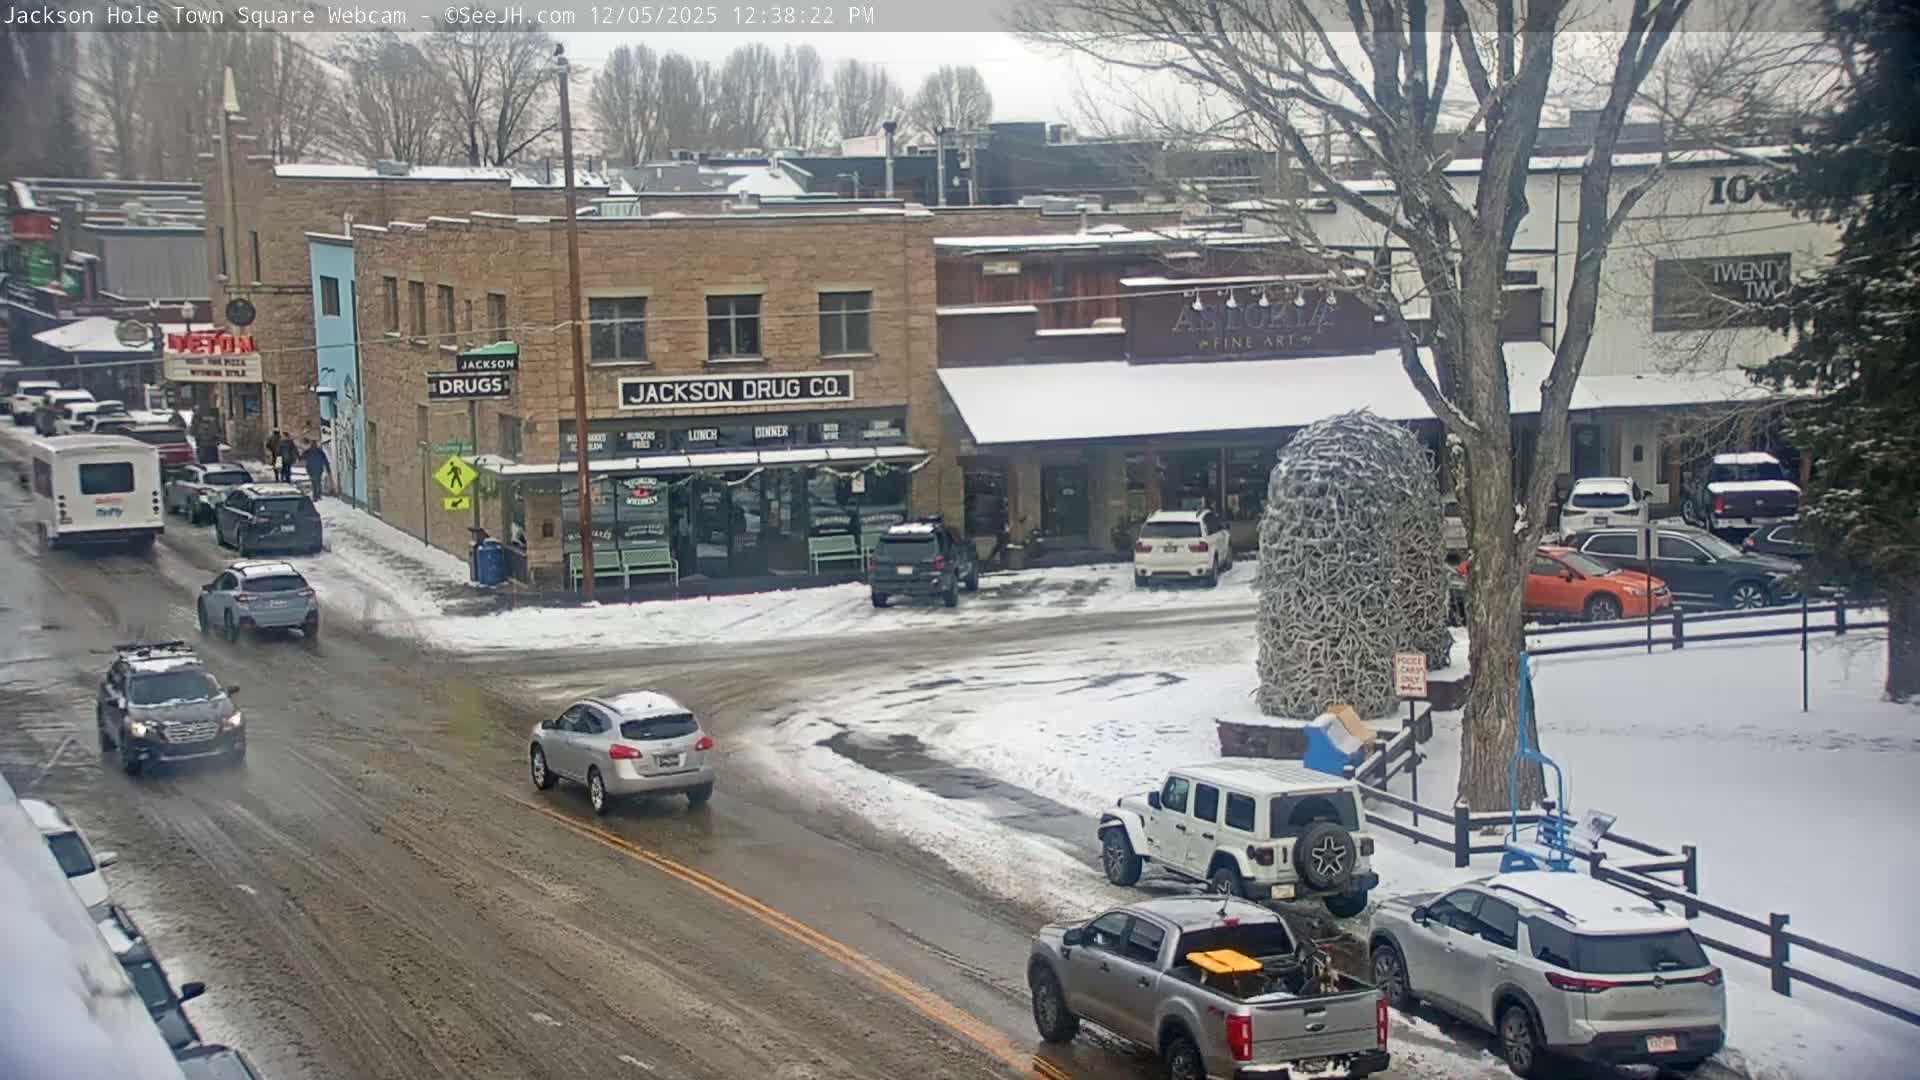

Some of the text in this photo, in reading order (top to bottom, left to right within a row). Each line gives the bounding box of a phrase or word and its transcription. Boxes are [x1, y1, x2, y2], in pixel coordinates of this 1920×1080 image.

[1713, 261, 1788, 283] TWENTY
[1743, 281, 1788, 300] TWO
[1213, 335, 1296, 349] FINE ART
[461, 358, 515, 370] JACKSON
[438, 377, 503, 395] DRUGS
[629, 377, 842, 404] JACKSON DRUG CO.
[626, 431, 656, 441] BURGERS
[688, 428, 718, 441] LUNCH
[755, 424, 789, 439] DINNER
